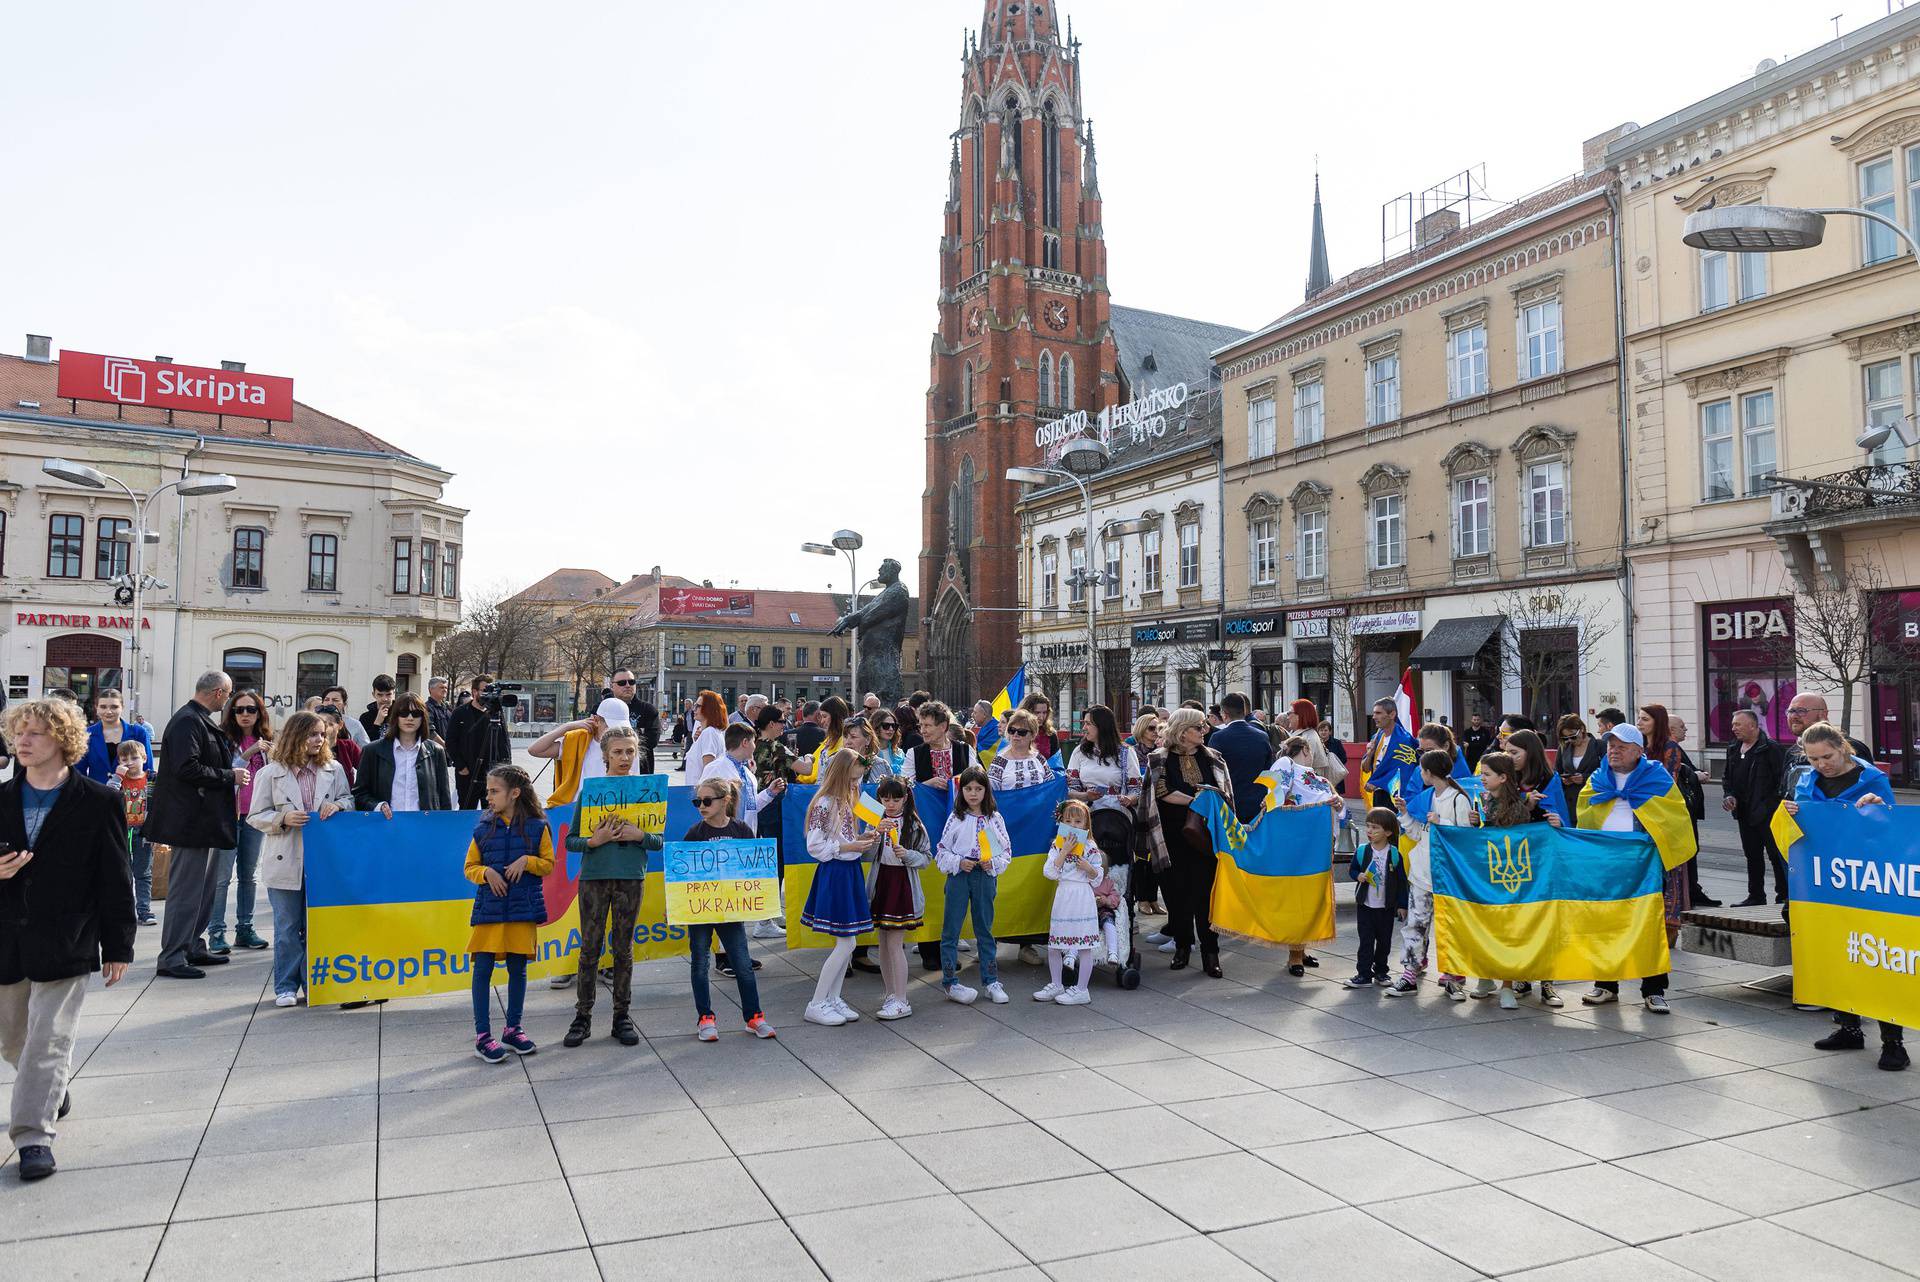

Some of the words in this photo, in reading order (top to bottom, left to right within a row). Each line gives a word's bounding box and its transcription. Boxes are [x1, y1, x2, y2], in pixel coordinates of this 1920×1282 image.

[157, 370, 266, 406] Skripta
[1111, 382, 1188, 430] HRVATSKO
[1035, 409, 1087, 447] OSJEČKO
[1131, 414, 1166, 446] PIVO
[17, 612, 91, 628] PARTNER
[1287, 610, 1310, 620] PIZZERIA
[1710, 609, 1789, 640] BIPA
[672, 849, 730, 875] STOP
[736, 846, 777, 869] WAR
[686, 882, 719, 894] PRAY
[735, 880, 762, 891] FOR
[1813, 856, 1821, 886] I
[1830, 857, 1920, 898] STAND
[689, 896, 765, 915] UKRAINE
